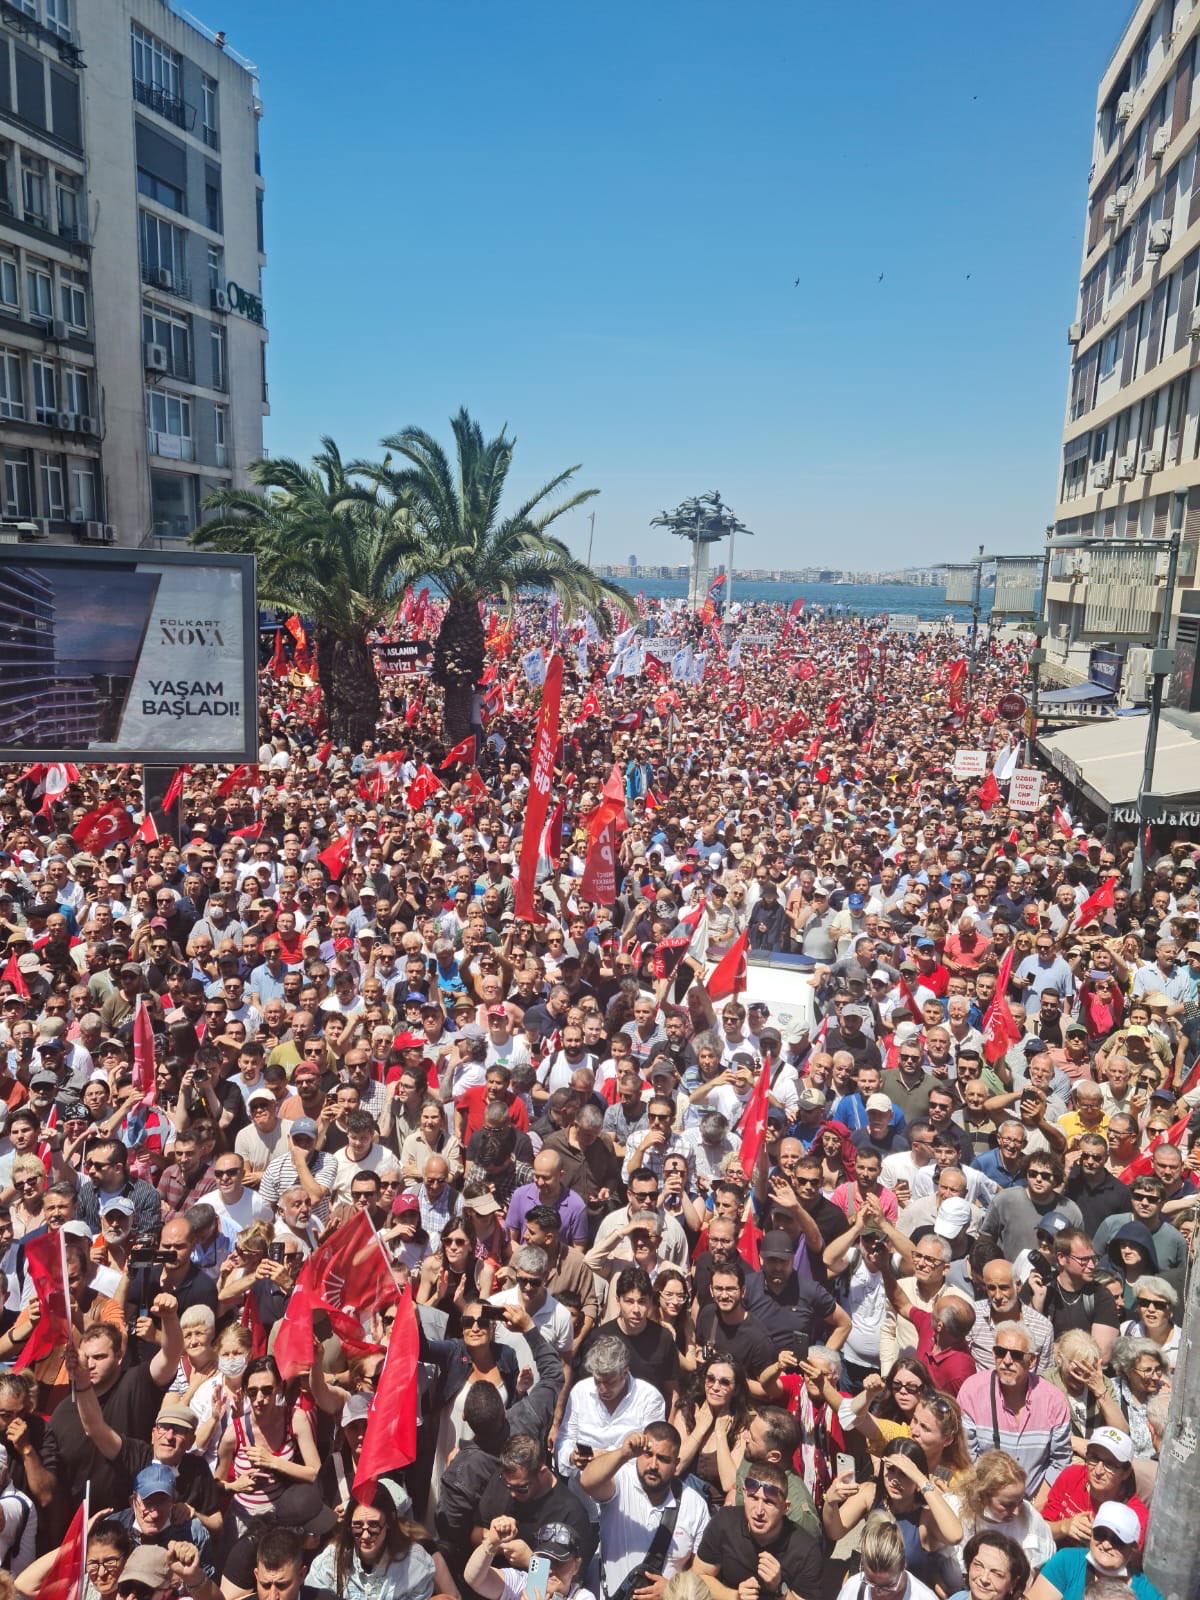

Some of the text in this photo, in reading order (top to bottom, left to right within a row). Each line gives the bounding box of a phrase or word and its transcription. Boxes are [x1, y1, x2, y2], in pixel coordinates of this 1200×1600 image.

[160, 619, 220, 627] FOLKART
[161, 627, 224, 647] NOVA
[388, 646, 418, 656] ASLANIM
[148, 680, 224, 700] YAŞAM
[142, 700, 240, 720] BAŞLADI!
